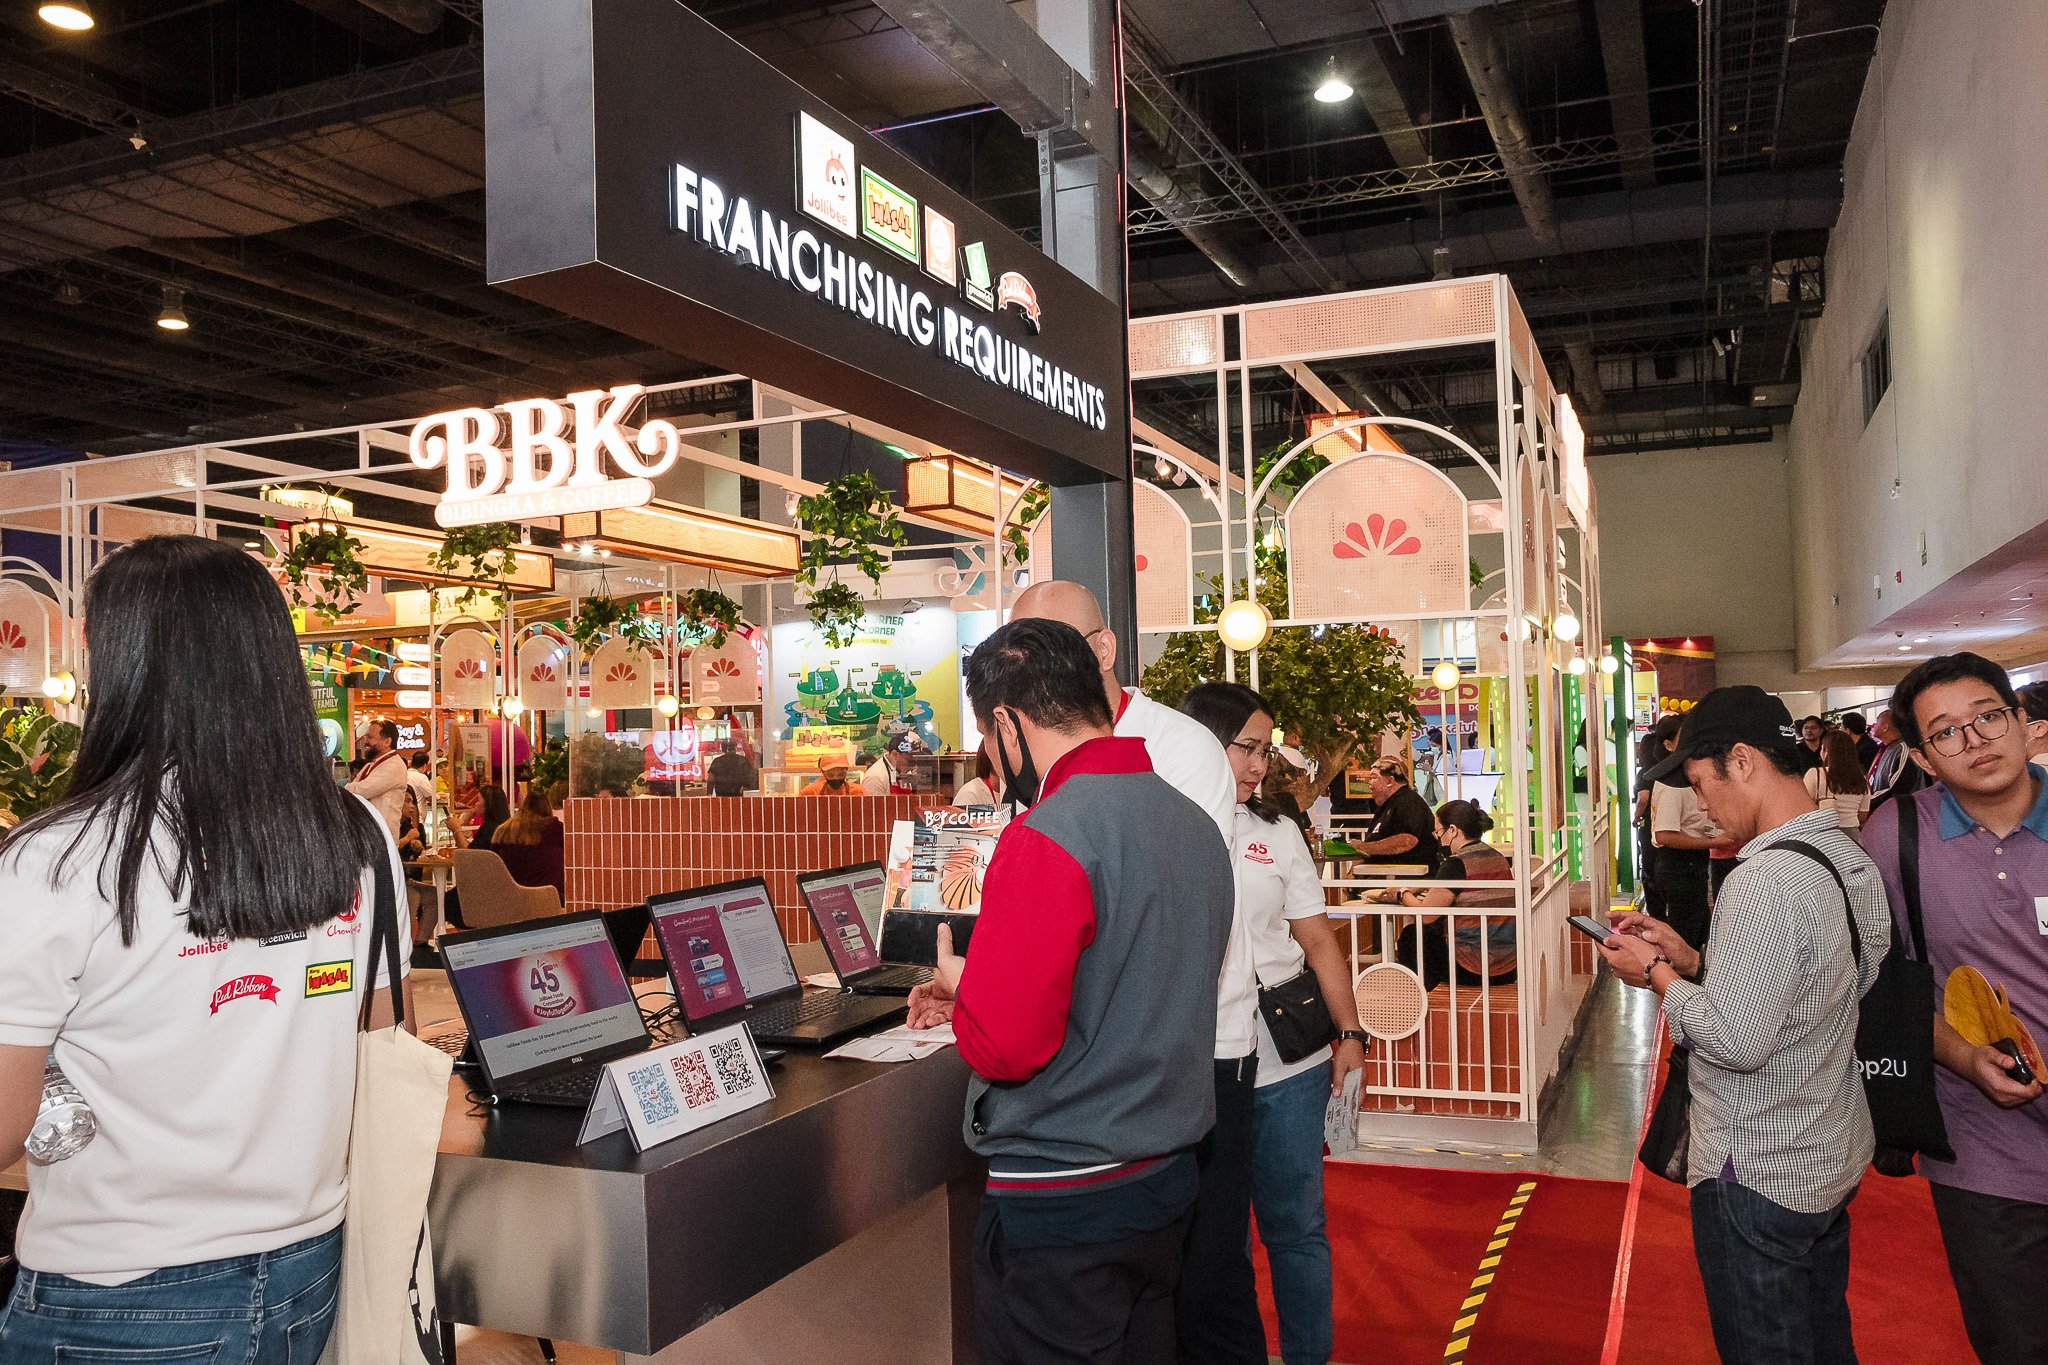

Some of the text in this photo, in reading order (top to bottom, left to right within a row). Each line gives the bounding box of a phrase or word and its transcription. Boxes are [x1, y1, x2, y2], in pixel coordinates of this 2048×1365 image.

[808, 191, 848, 226] Jollibee
[868, 194, 912, 239] INASAL
[676, 162, 1106, 431] FRANCHISING REQUIREMENTS
[408, 384, 681, 502] BBK
[440, 484, 644, 521] BIBINGKA & COFFEE
[414, 723, 425, 737] &
[948, 811, 1000, 825] COFFEE
[1247, 842, 1268, 855] 45
[178, 942, 229, 957] Jollibee
[259, 931, 307, 948] greenwich
[214, 976, 269, 1007] Red Ribbon
[308, 967, 349, 990] INASAL
[530, 964, 560, 994] 45
